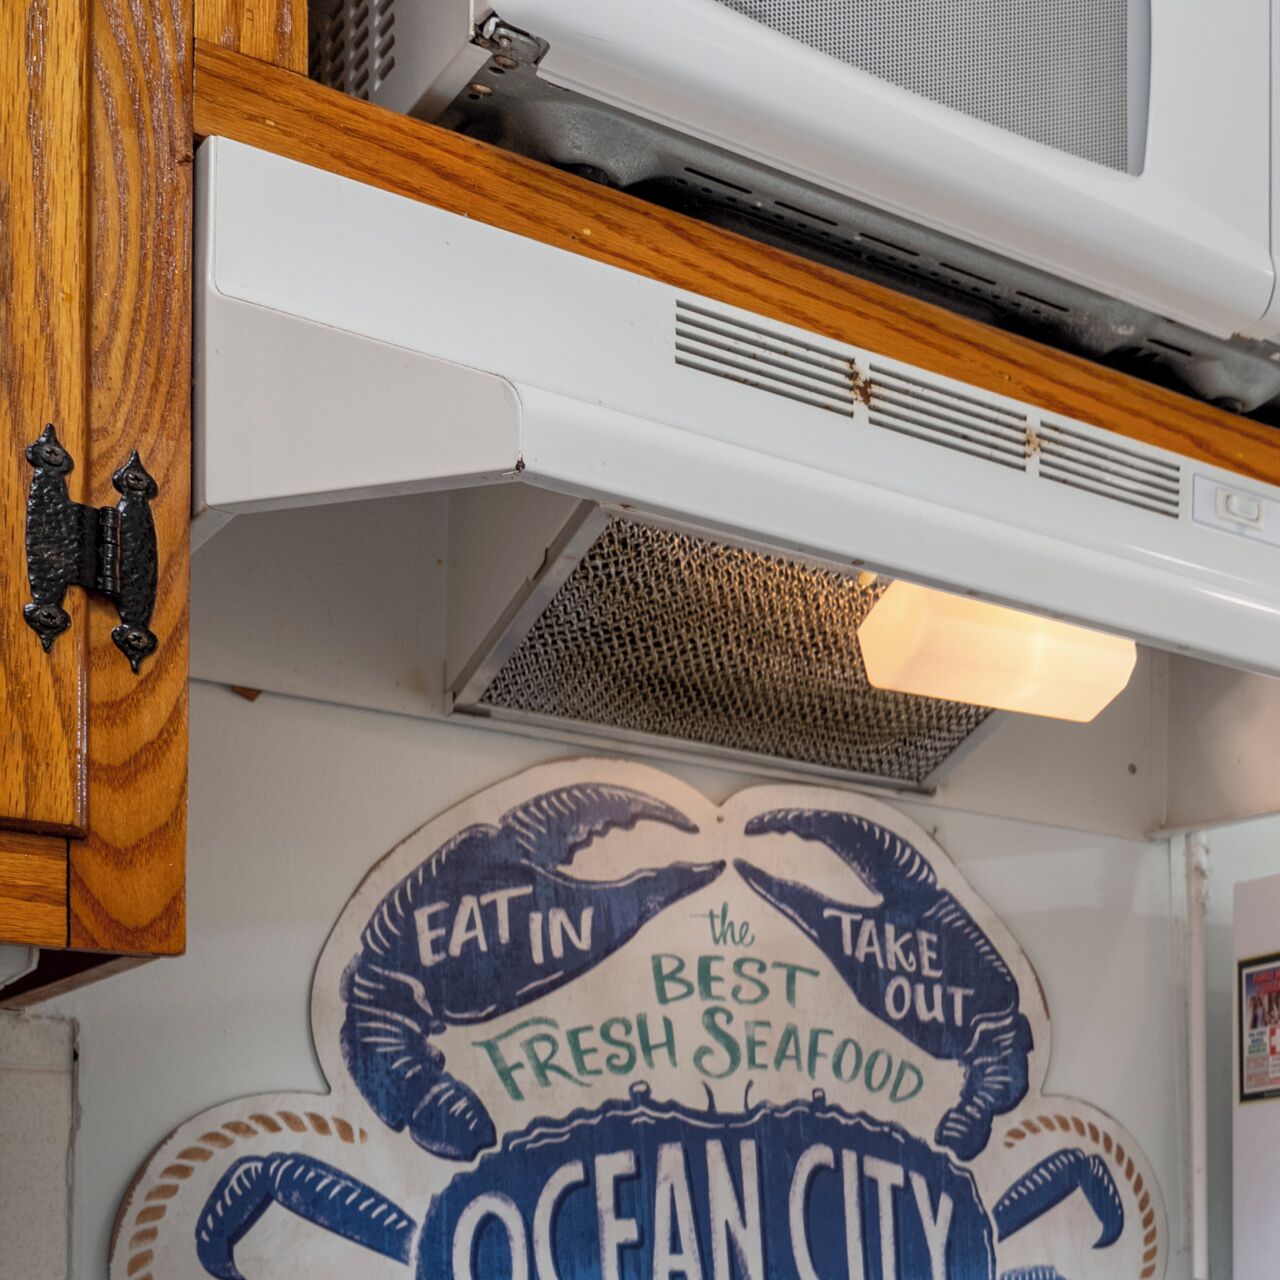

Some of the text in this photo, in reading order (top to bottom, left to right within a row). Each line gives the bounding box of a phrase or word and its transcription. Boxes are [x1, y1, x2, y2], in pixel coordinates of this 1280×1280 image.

[413, 885, 595, 968] EAT IN
[689, 901, 757, 949] the
[822, 907, 944, 978] TAKE
[651, 952, 821, 1007] BEST
[885, 974, 976, 1027] OUT
[472, 1005, 926, 1104] FRESH SEAFOOD
